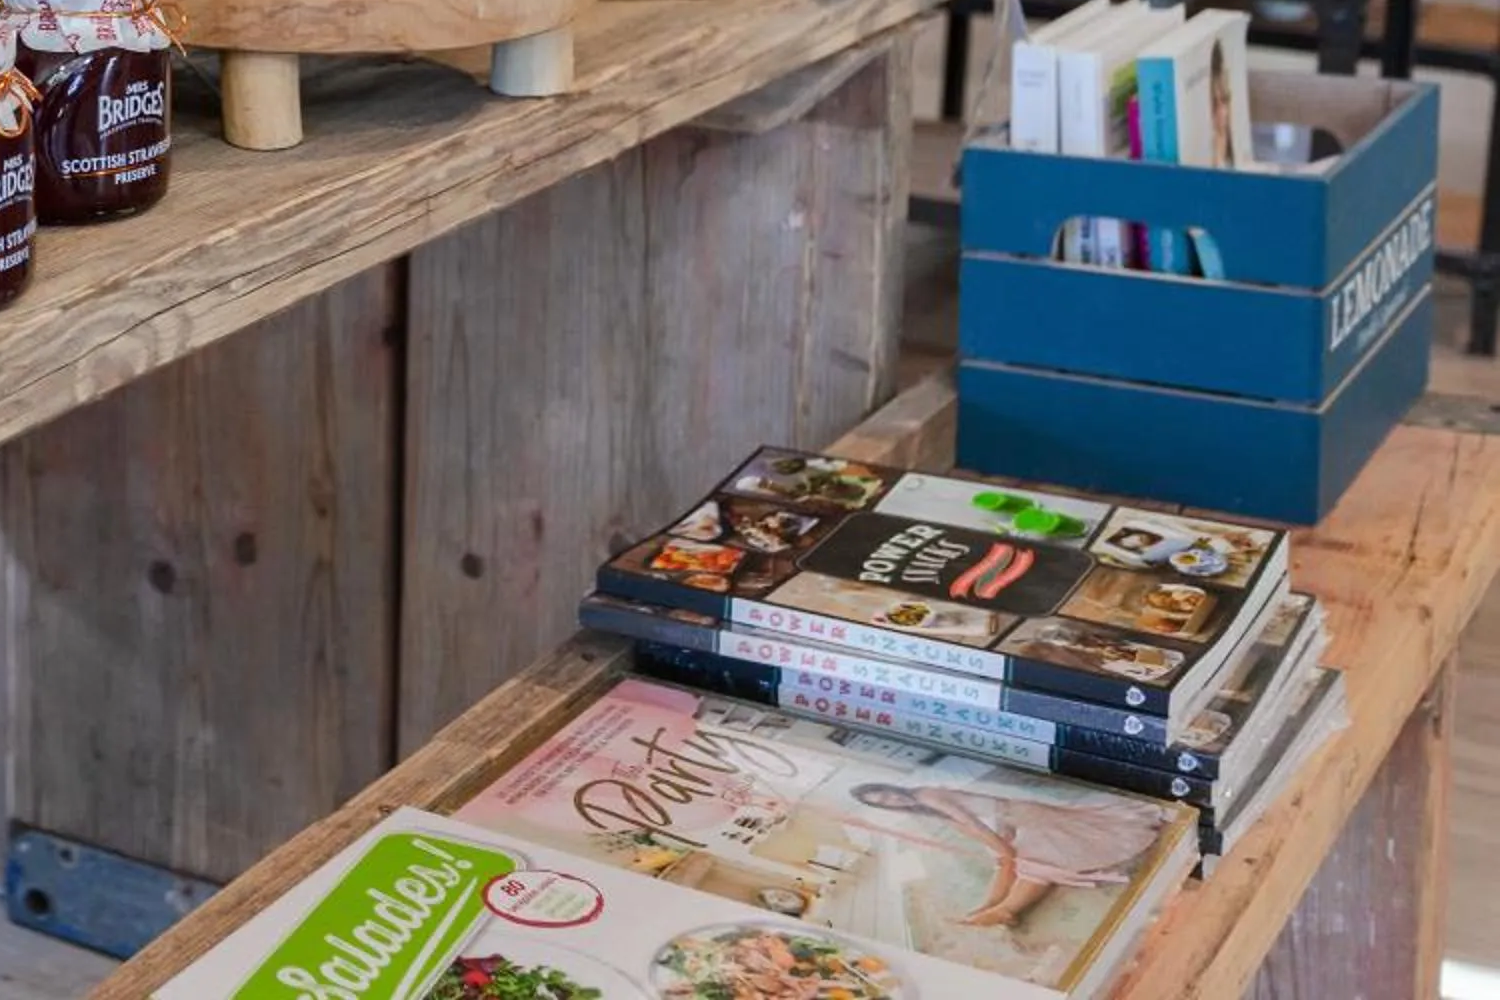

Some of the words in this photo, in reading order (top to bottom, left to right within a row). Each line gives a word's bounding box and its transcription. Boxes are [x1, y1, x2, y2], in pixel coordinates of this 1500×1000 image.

[98, 81, 164, 132] BRIDGES
[61, 154, 127, 175] SCOTTISH
[115, 163, 156, 185] PRESERVE
[1330, 199, 1433, 353] LEMONADE
[859, 524, 945, 584] POWER
[748, 607, 847, 641] POWER
[860, 632, 985, 671] SNACKS
[736, 640, 838, 672] POWER
[853, 664, 980, 701] SNACKS
[794, 693, 893, 727] POWER
[906, 720, 1030, 758] SNACKS
[798, 672, 897, 705] POWER
[911, 698, 1037, 735] SNACKS
[573, 727, 799, 849] Party
